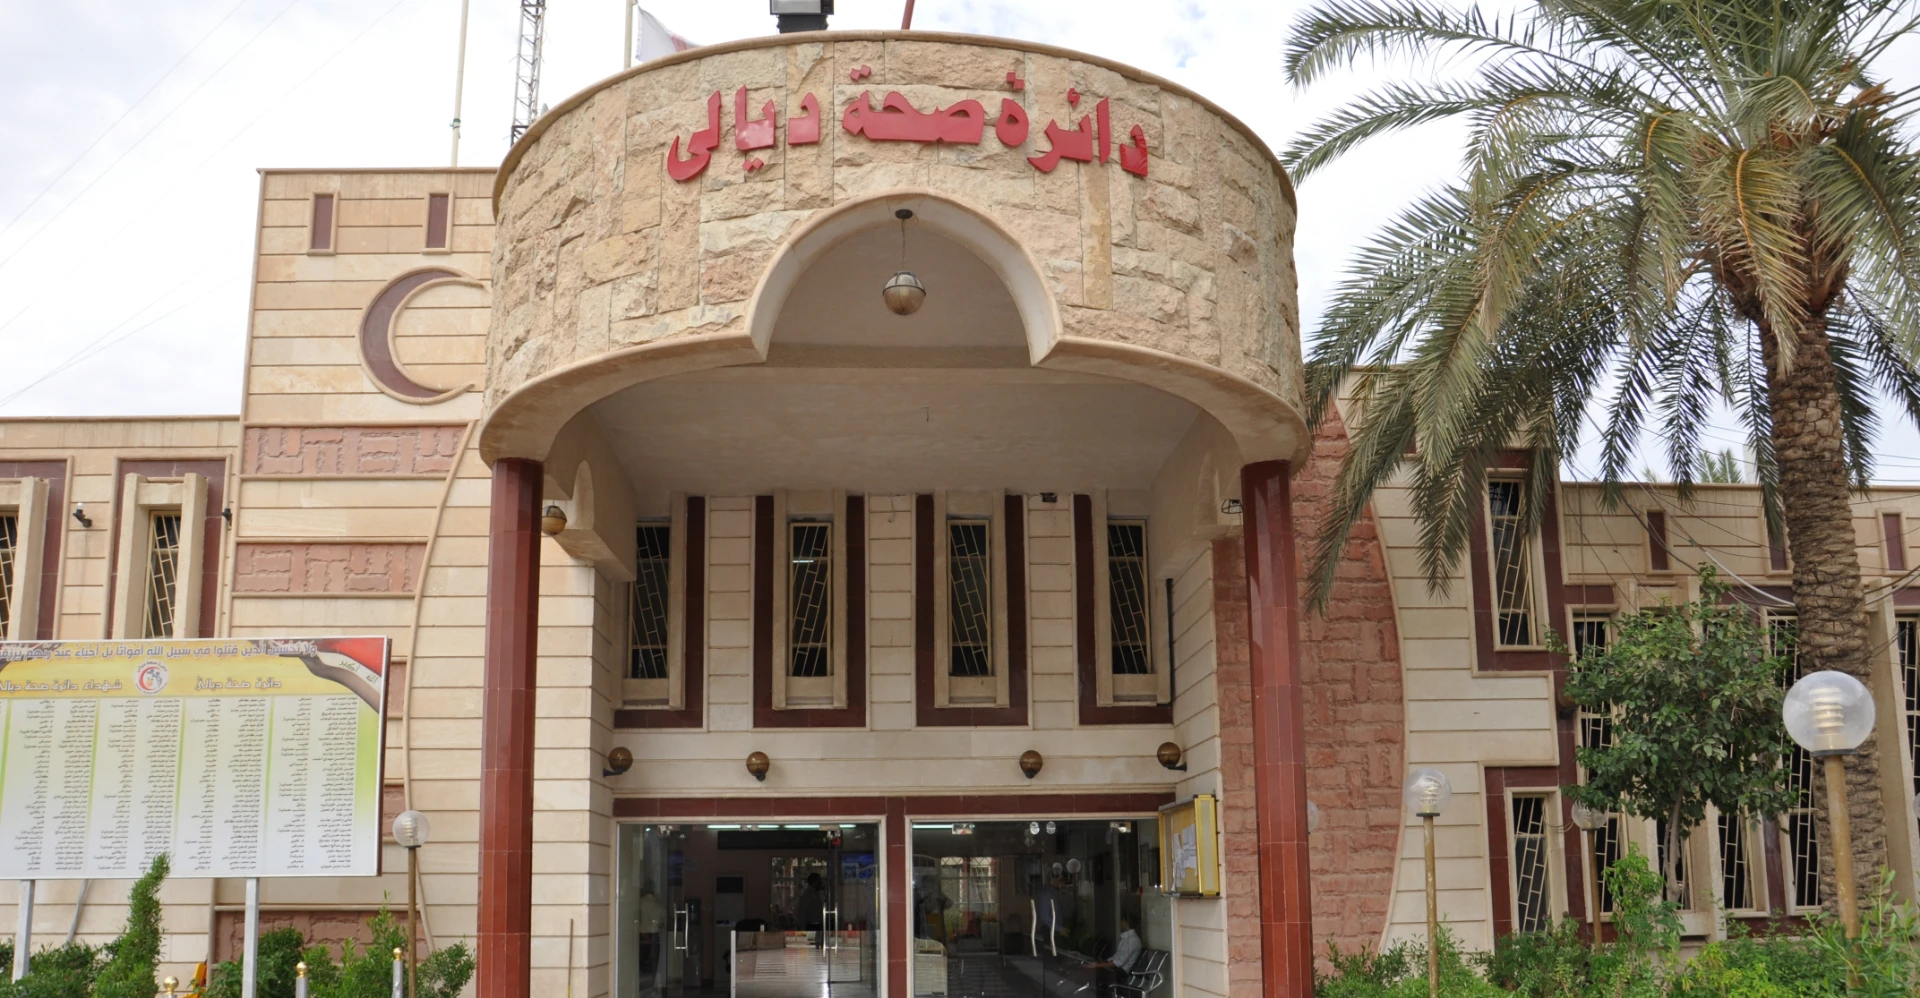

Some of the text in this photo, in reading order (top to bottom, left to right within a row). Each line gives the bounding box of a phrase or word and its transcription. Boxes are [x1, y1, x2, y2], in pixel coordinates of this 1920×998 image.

[842, 65, 985, 144] صحة
[667, 84, 820, 181] ديالى
[25, 680, 50, 691] صحة
[52, 679, 78, 692] دائرة
[83, 679, 122, 692] شهداء
[225, 677, 251, 689] صحة
[254, 677, 282, 690] دائرة
